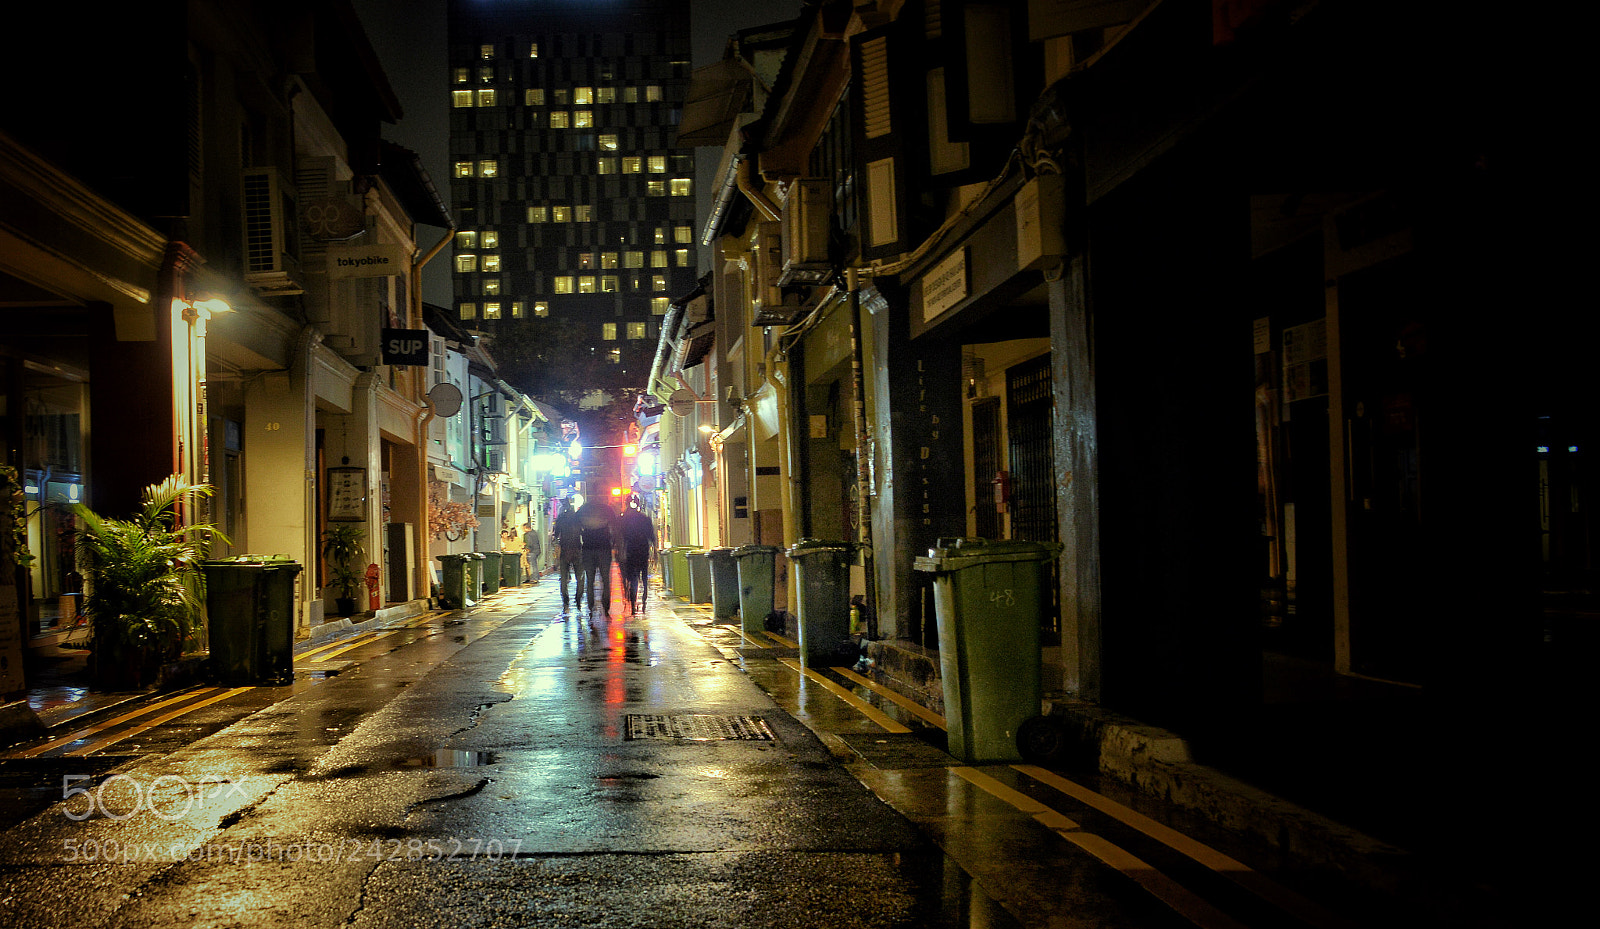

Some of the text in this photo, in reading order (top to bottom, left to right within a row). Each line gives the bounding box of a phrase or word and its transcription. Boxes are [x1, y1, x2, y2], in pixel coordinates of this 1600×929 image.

[337, 256, 389, 267] tokyobike
[388, 338, 423, 355] SUP
[990, 589, 1015, 608] 48
